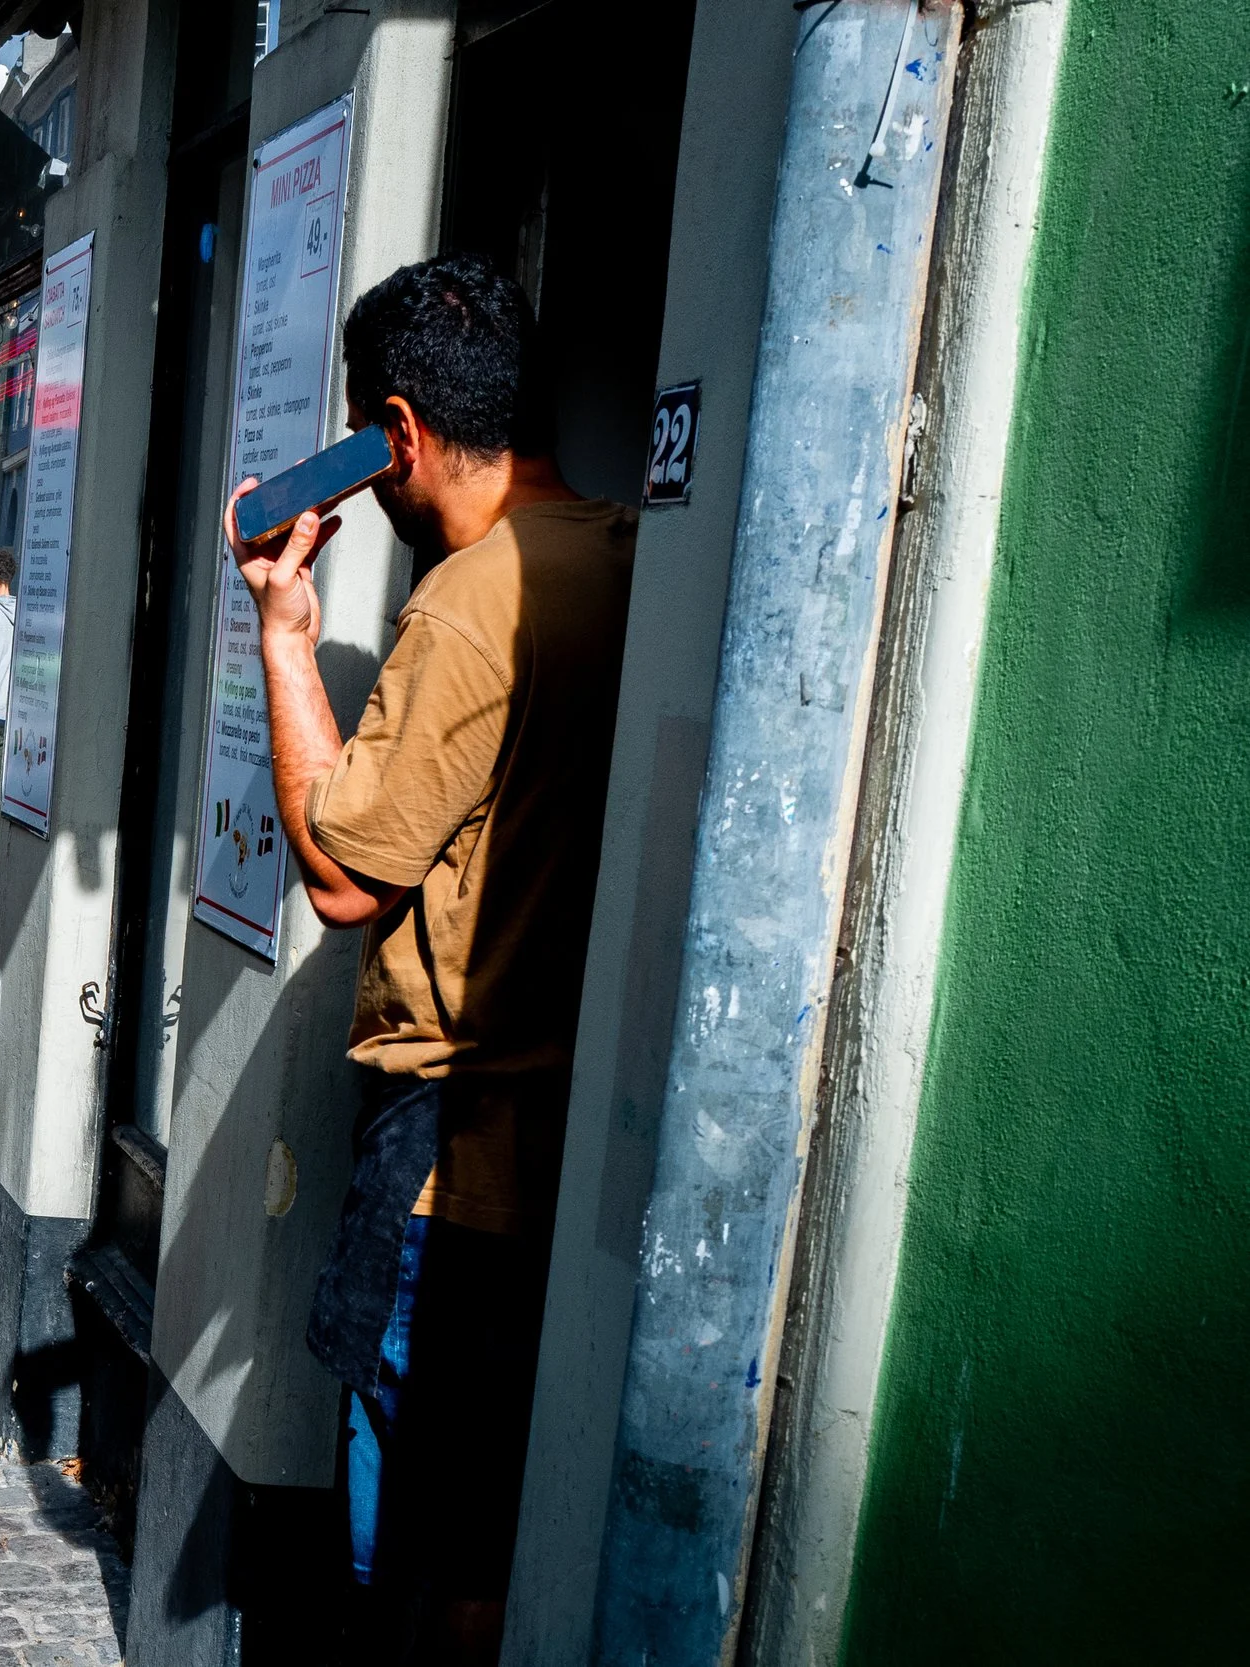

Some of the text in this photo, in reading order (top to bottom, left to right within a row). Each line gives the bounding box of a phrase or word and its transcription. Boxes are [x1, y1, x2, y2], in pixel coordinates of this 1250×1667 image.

[270, 155, 321, 209] MINI PIZZA
[306, 216, 328, 258] 49,-
[250, 341, 272, 360] Pepperoni
[649, 403, 692, 485] 22
[224, 680, 238, 700] Kylling
[244, 685, 257, 700] pesto
[242, 729, 248, 745] og
[248, 730, 260, 744] pesto
